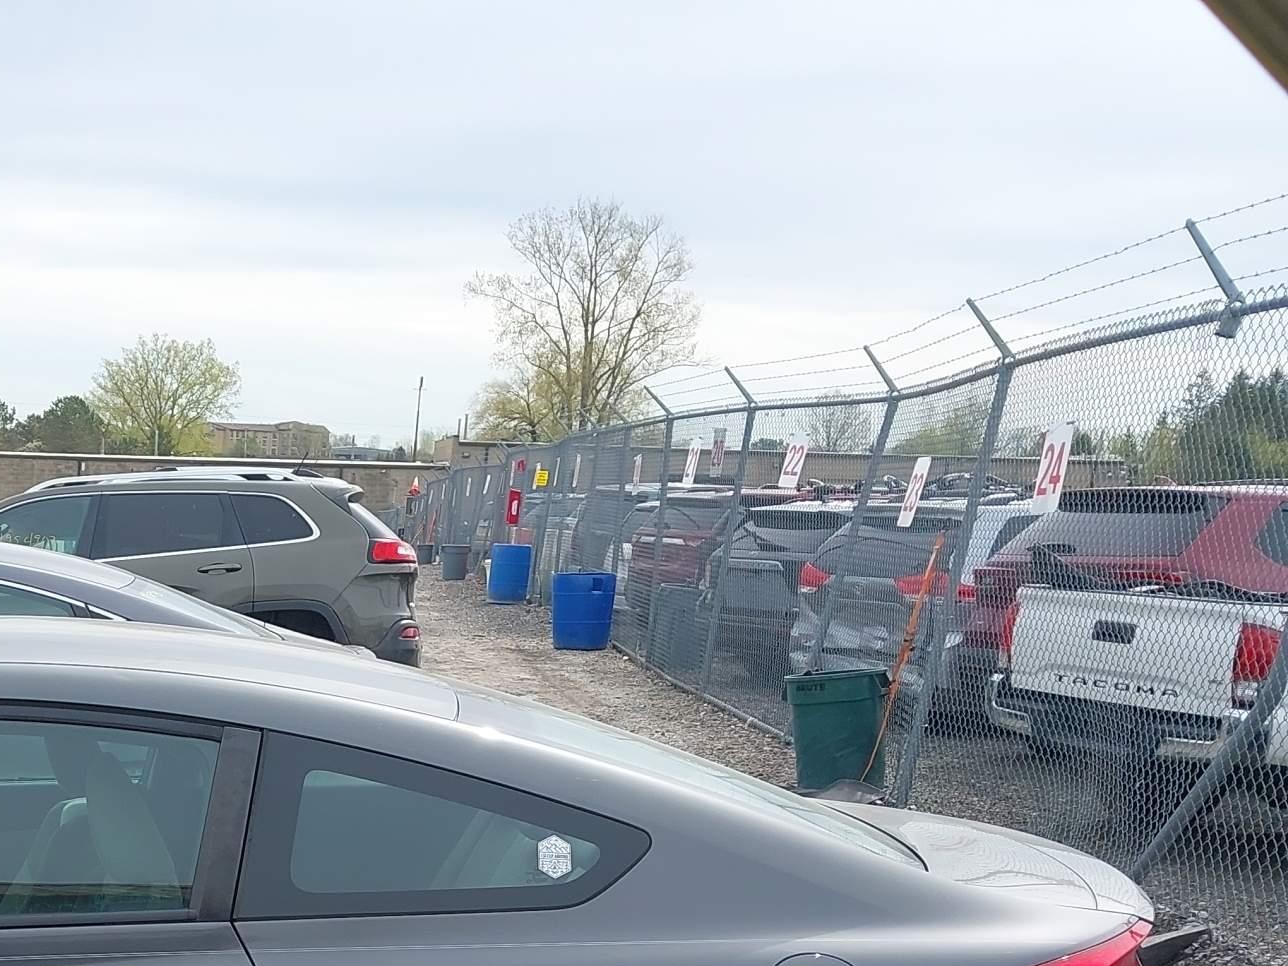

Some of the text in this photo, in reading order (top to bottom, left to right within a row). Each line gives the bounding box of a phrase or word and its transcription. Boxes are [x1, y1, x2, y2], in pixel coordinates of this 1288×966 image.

[684, 447, 700, 478] 21
[783, 444, 806, 477] 22
[1036, 441, 1066, 496] 24
[902, 472, 924, 513] 23
[1054, 673, 1179, 698] TACOMA
